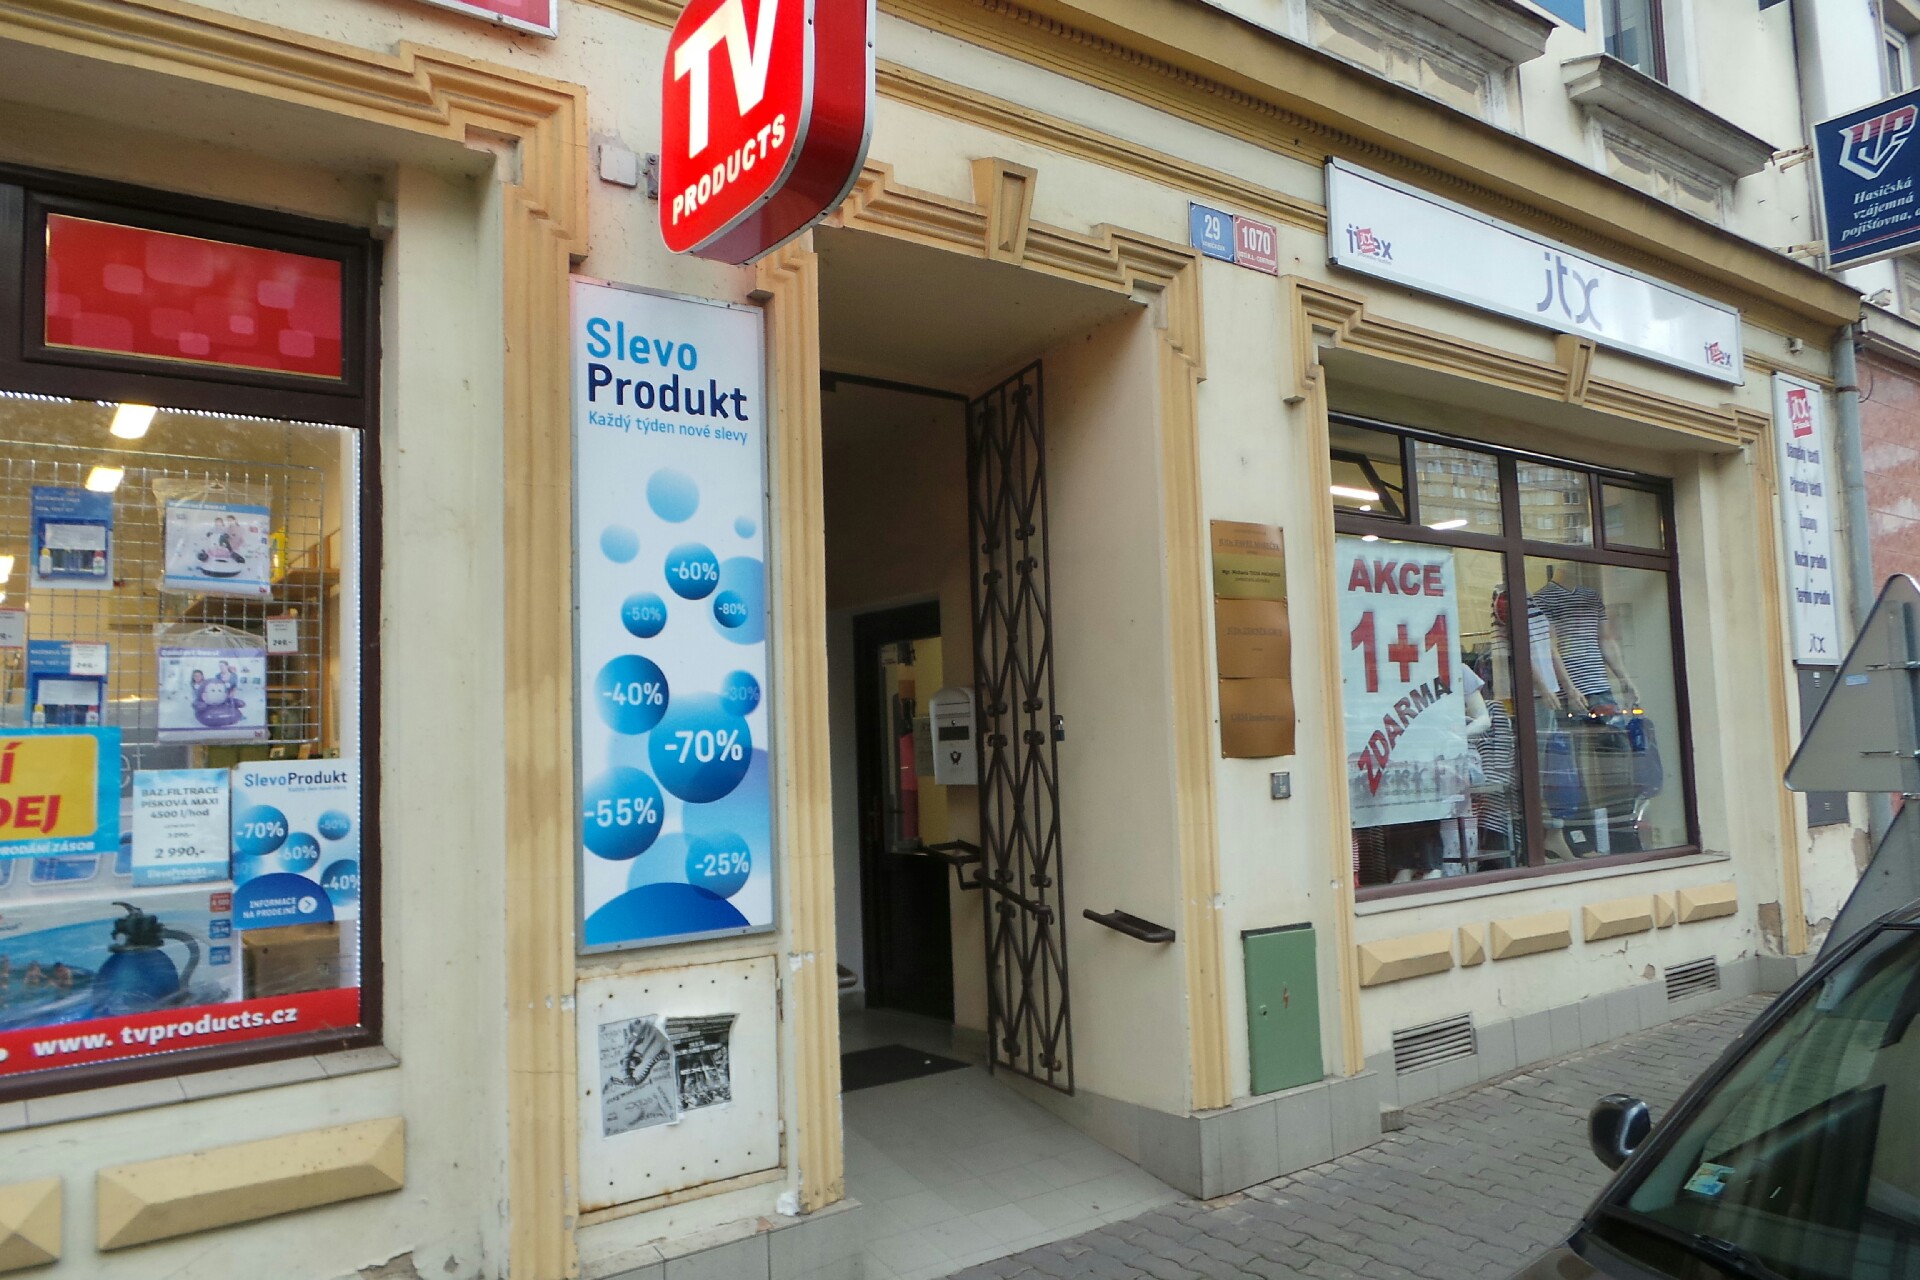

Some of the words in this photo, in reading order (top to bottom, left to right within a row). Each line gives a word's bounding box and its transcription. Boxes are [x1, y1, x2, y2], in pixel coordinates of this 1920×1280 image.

[674, 0, 779, 159] TV
[672, 113, 786, 225] PRODUCTS
[1853, 176, 1912, 205] Hasičská
[1852, 191, 1914, 221] vzájemná
[1204, 214, 1221, 241] 29
[1242, 225, 1271, 255] 1070
[586, 317, 698, 371] Slevo
[588, 362, 749, 422] Produkt
[589, 411, 631, 434] Každý
[636, 417, 675, 435] týden
[679, 424, 710, 438] nové
[715, 429, 748, 445] slevy
[671, 562, 718, 581] -60%
[1347, 558, 1444, 597] AKCE
[625, 607, 661, 621] -50%
[718, 603, 747, 615] -80%
[1351, 611, 1451, 693] 1+1
[603, 682, 664, 706] -40%
[664, 729, 743, 764] -70%
[1357, 675, 1453, 797] ZDARMA
[244, 770, 348, 787] SlevoProdukt
[583, 797, 656, 828] -55%
[236, 822, 284, 839] -70%
[154, 848, 164, 859] 2
[168, 846, 205, 858] 990,-
[695, 852, 749, 877] -25%
[33, 1030, 114, 1057] www.
[120, 1007, 298, 1046] tvproducts.cz
